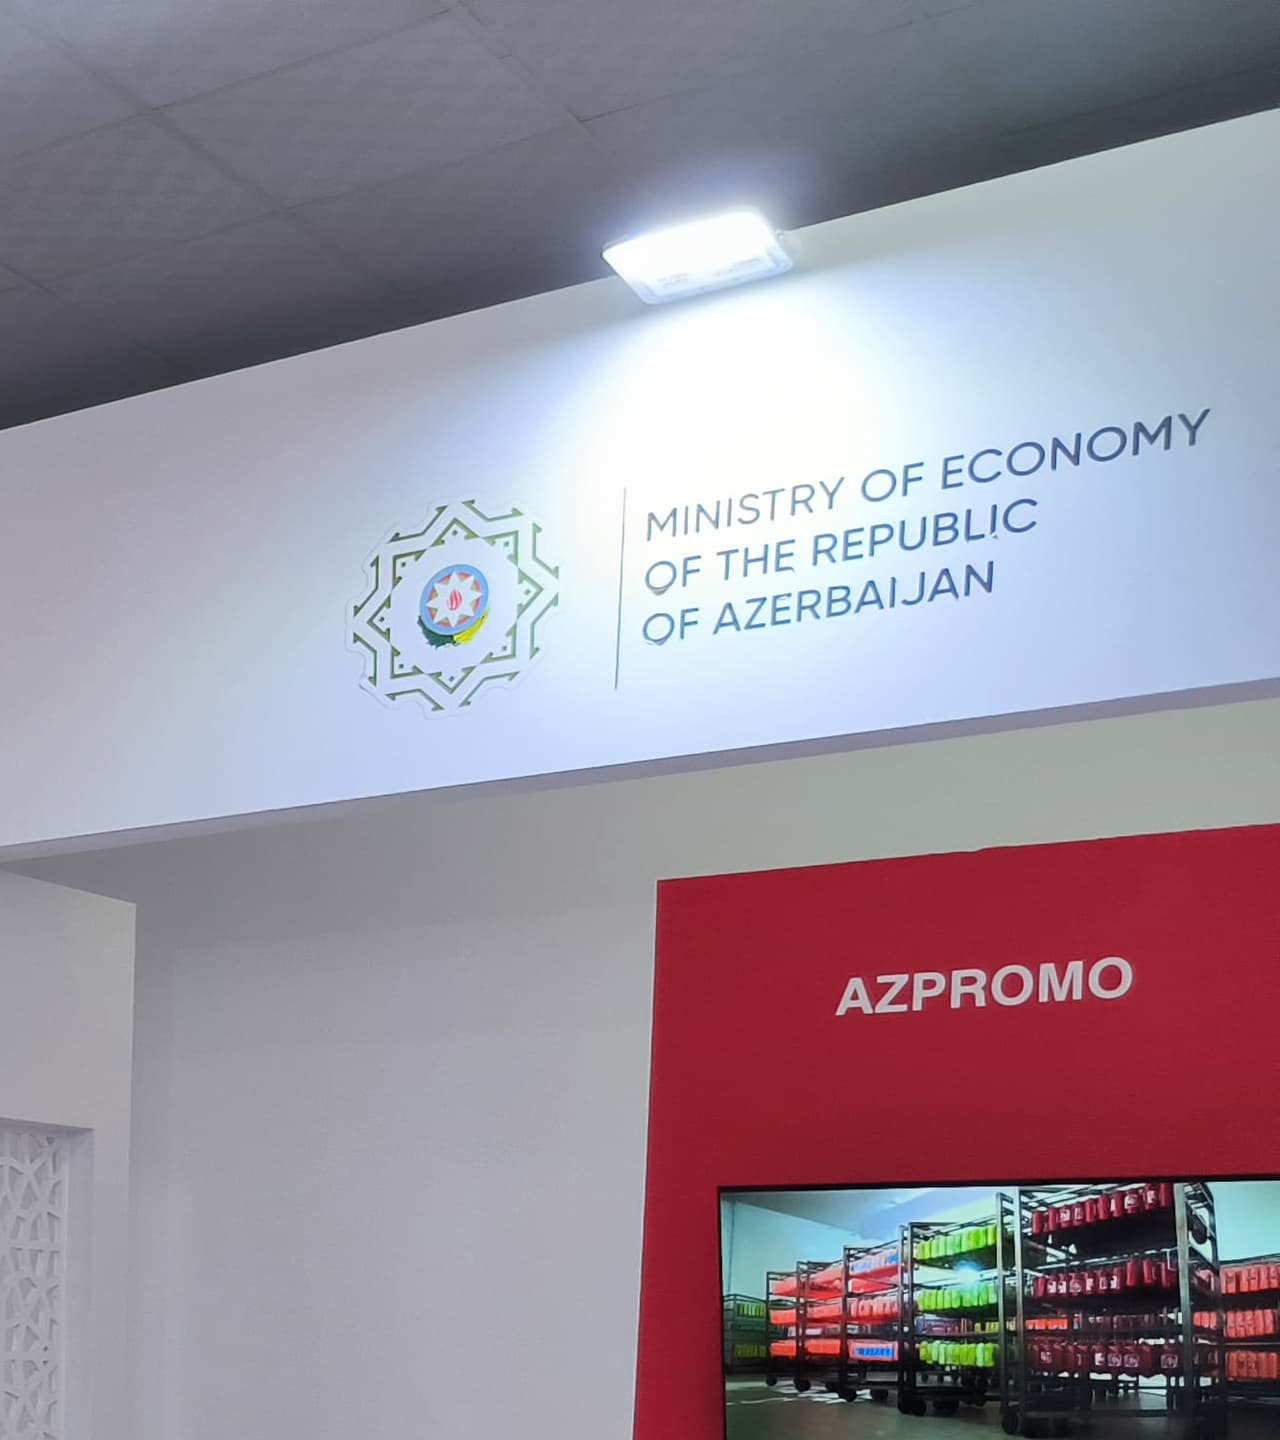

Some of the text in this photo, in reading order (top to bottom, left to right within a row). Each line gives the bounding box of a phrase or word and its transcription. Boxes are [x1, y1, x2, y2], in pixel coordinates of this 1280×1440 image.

[646, 408, 1211, 541] MINISTRY OF ECONOMY
[644, 498, 1038, 594] OF THE REPUBLIC
[642, 560, 995, 644] OF AZERBAIJAN
[836, 955, 1134, 1016] AZPROMO
